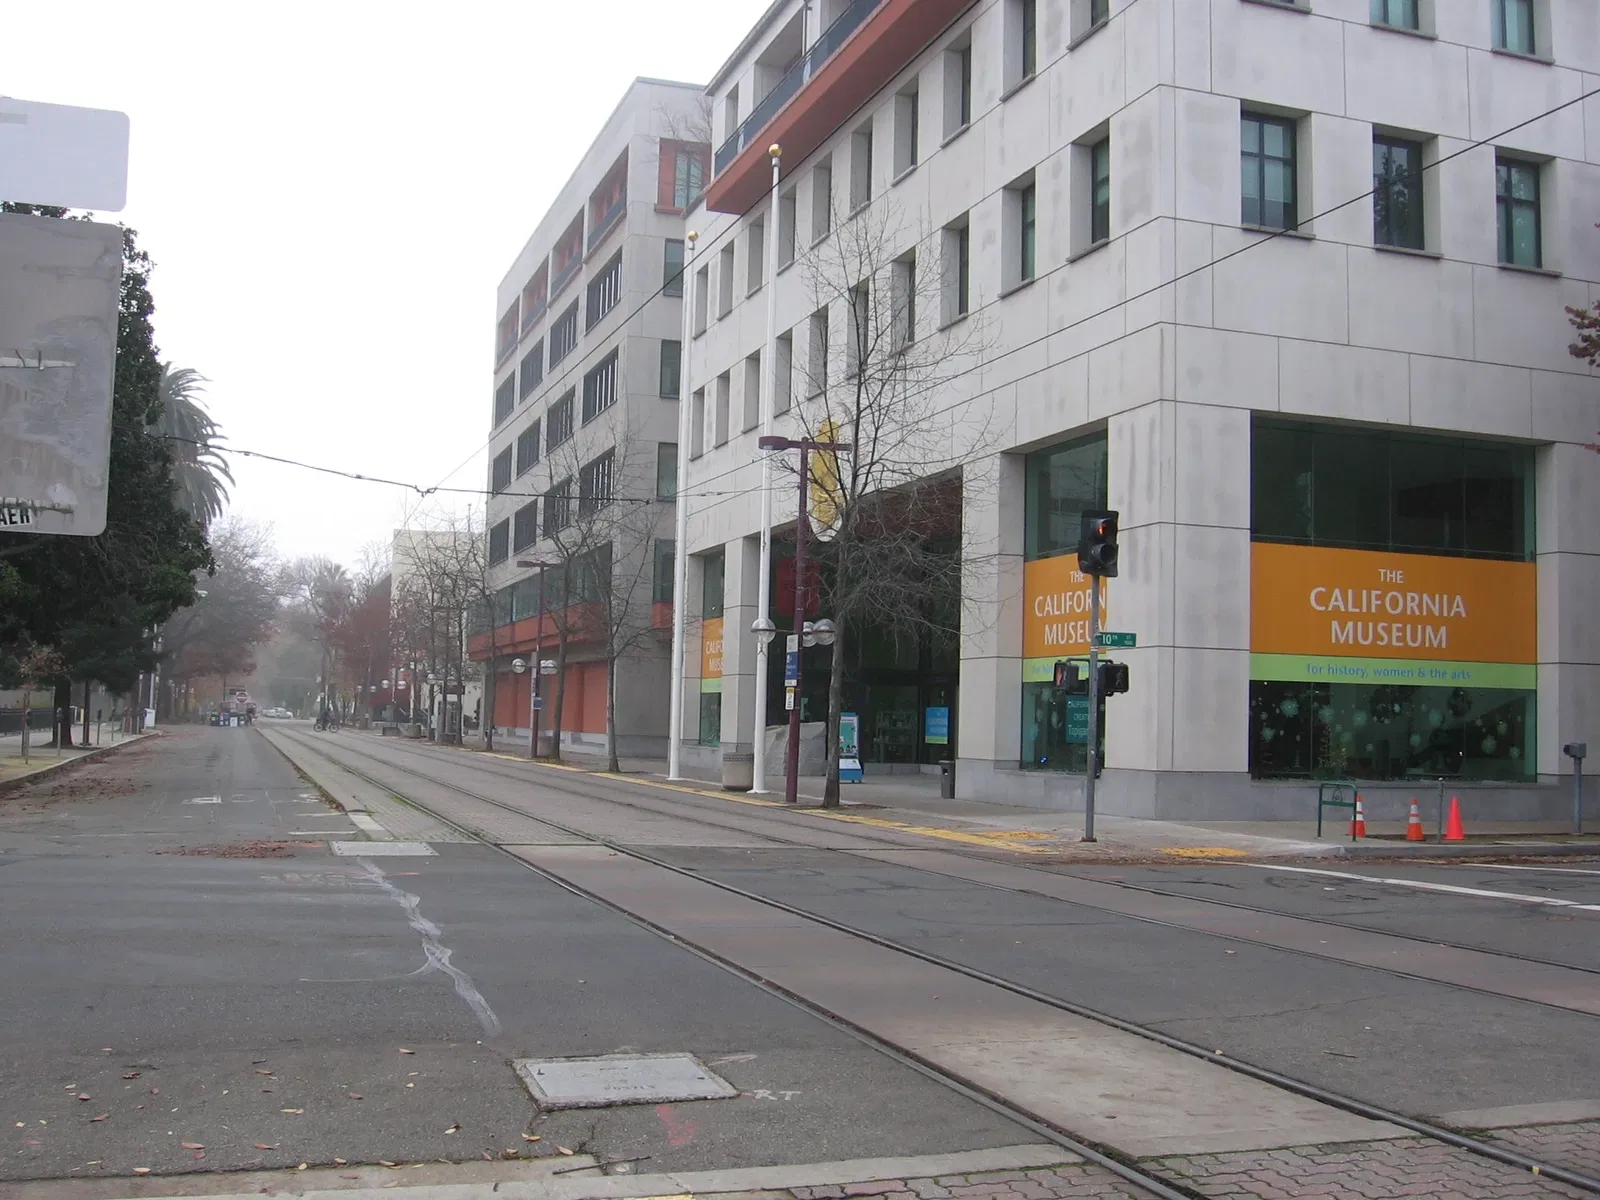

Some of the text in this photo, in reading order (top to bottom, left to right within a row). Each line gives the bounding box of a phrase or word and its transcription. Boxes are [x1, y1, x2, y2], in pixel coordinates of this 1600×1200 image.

[1070, 571, 1085, 583] THE
[1378, 569, 1404, 584] THE
[1309, 587, 1467, 618] CALIFORNIA
[1331, 620, 1447, 649] MUSEUM
[1307, 663, 1472, 680] for history, women & the arts
